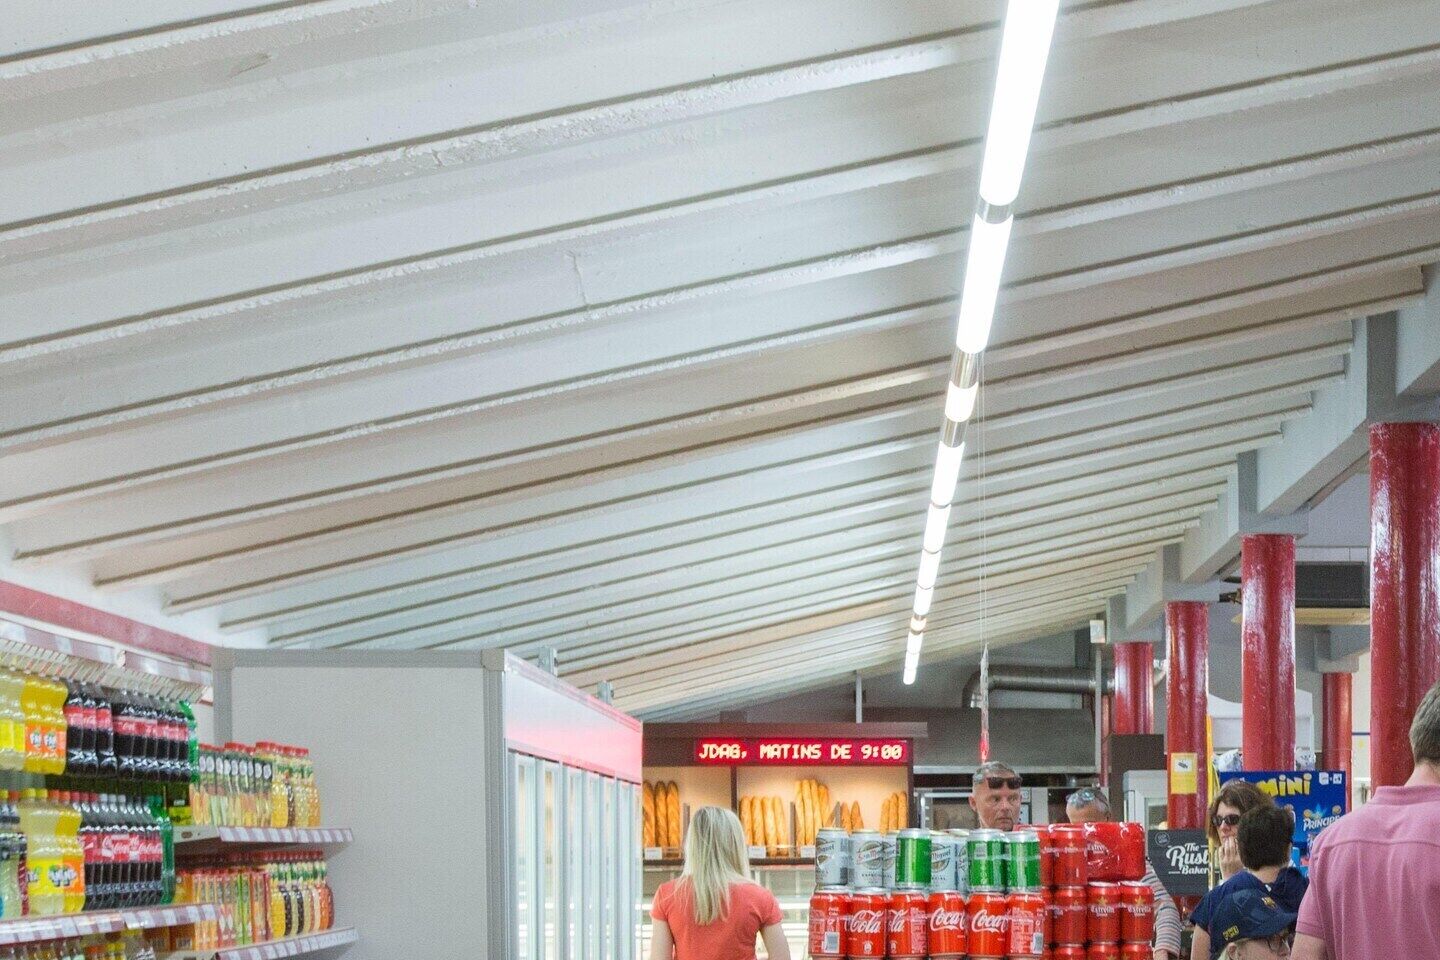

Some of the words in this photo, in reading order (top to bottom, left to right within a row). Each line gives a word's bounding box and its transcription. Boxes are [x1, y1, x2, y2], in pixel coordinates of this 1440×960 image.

[760, 744, 822, 759] MATINS
[831, 744, 852, 759] DE
[861, 744, 903, 759] 9:00
[1184, 843, 1200, 851] The
[1182, 865, 1209, 874] Baker
